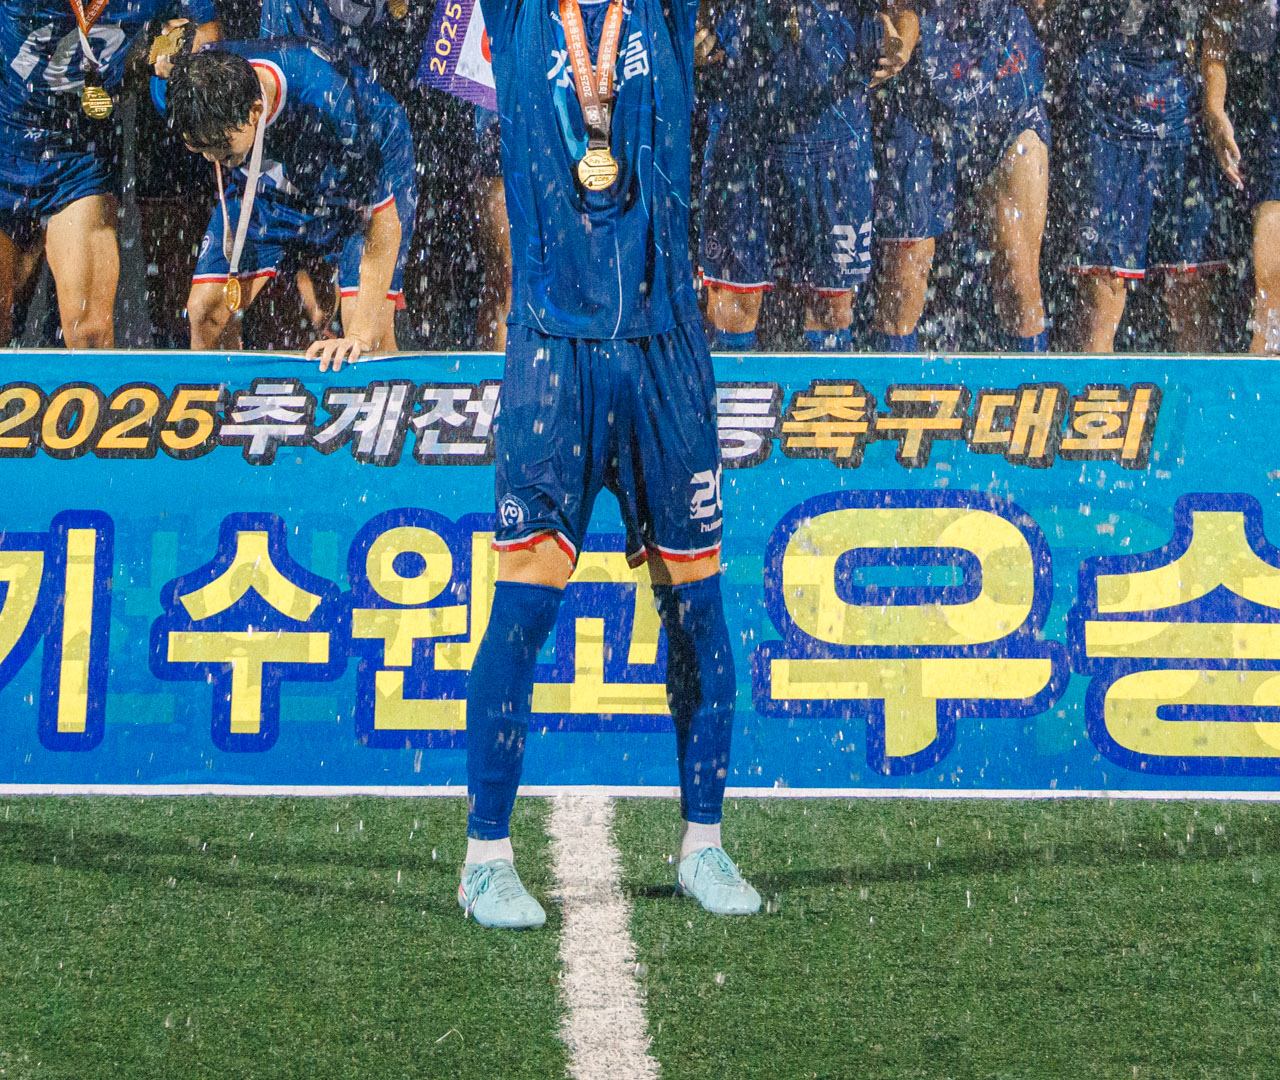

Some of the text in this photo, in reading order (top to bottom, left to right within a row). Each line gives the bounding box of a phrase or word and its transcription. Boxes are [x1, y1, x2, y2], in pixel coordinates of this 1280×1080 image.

[429, 2, 462, 76] 2025
[547, 31, 649, 91] 水高
[575, 57, 587, 74] 추계
[579, 74, 592, 97] 2025
[167, 526, 680, 734] 수원고
